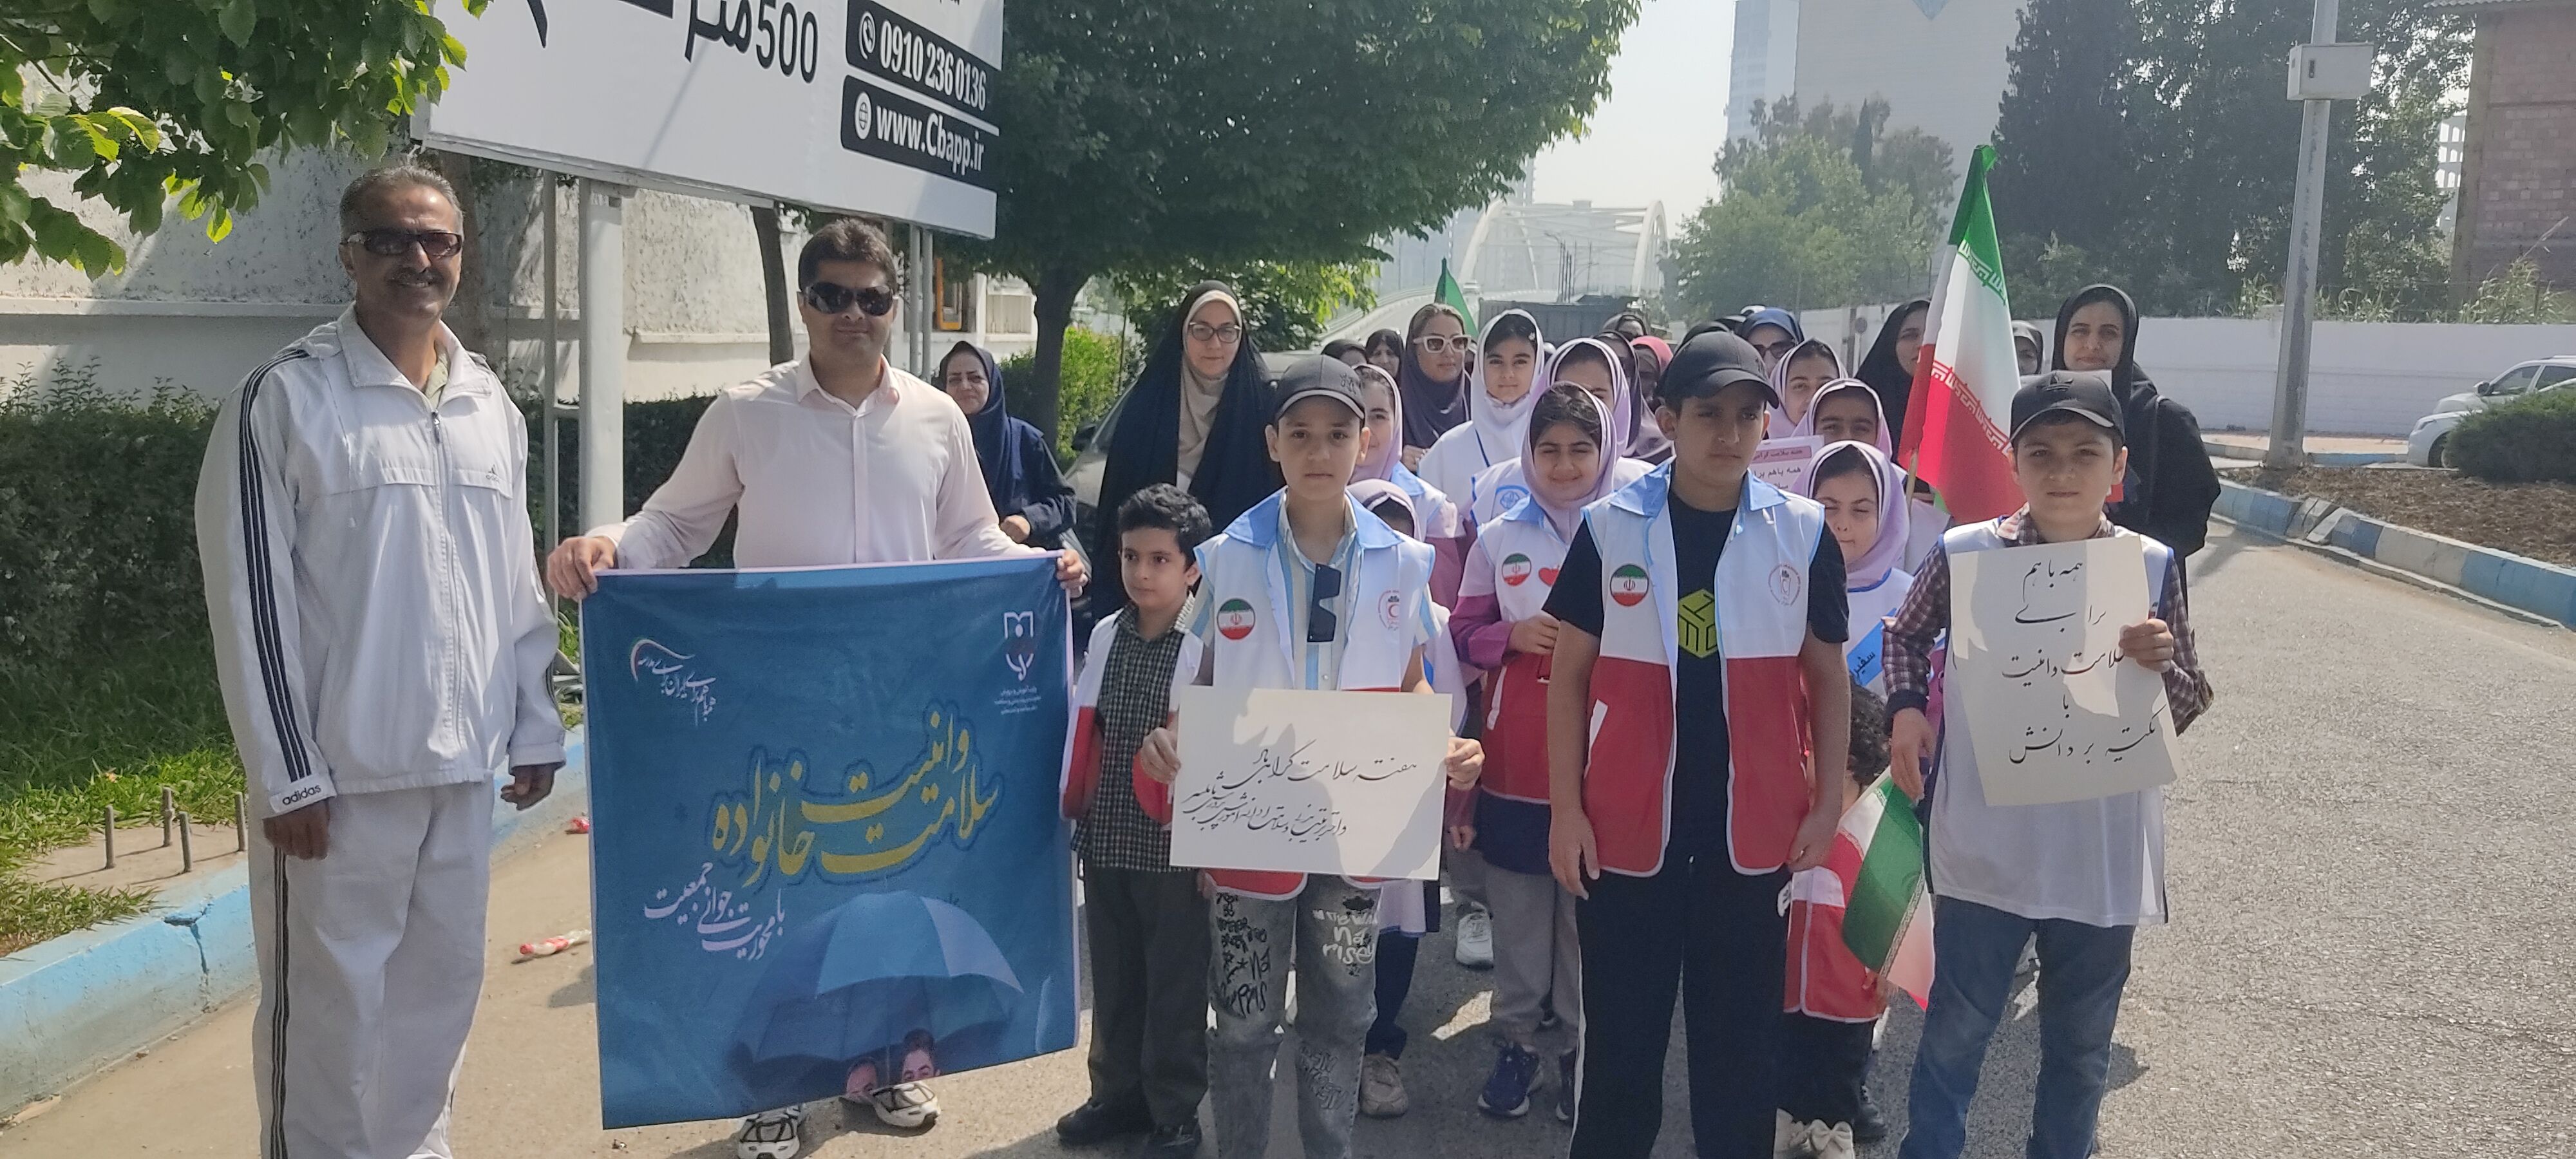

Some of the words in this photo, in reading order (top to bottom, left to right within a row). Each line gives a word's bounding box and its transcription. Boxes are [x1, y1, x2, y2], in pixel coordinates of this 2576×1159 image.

[756, 0, 819, 84] 500
[880, 20, 924, 82] 0910
[925, 41, 954, 97] 236
[954, 57, 987, 111] 0136
[876, 104, 985, 176] www.Cbapp.ir
[2060, 562, 2083, 581] همه
[1853, 652, 1875, 681] سفیر
[2063, 694, 2069, 718] با
[801, 710, 954, 824] امنیت
[1352, 757, 1417, 782] هفته
[2009, 726, 2074, 764] دانش
[282, 785, 321, 805] adidas
[1287, 760, 1357, 782] سلامت
[712, 758, 815, 889] خانواده
[820, 764, 999, 874] سلامت
[644, 862, 714, 925] جمعیت
